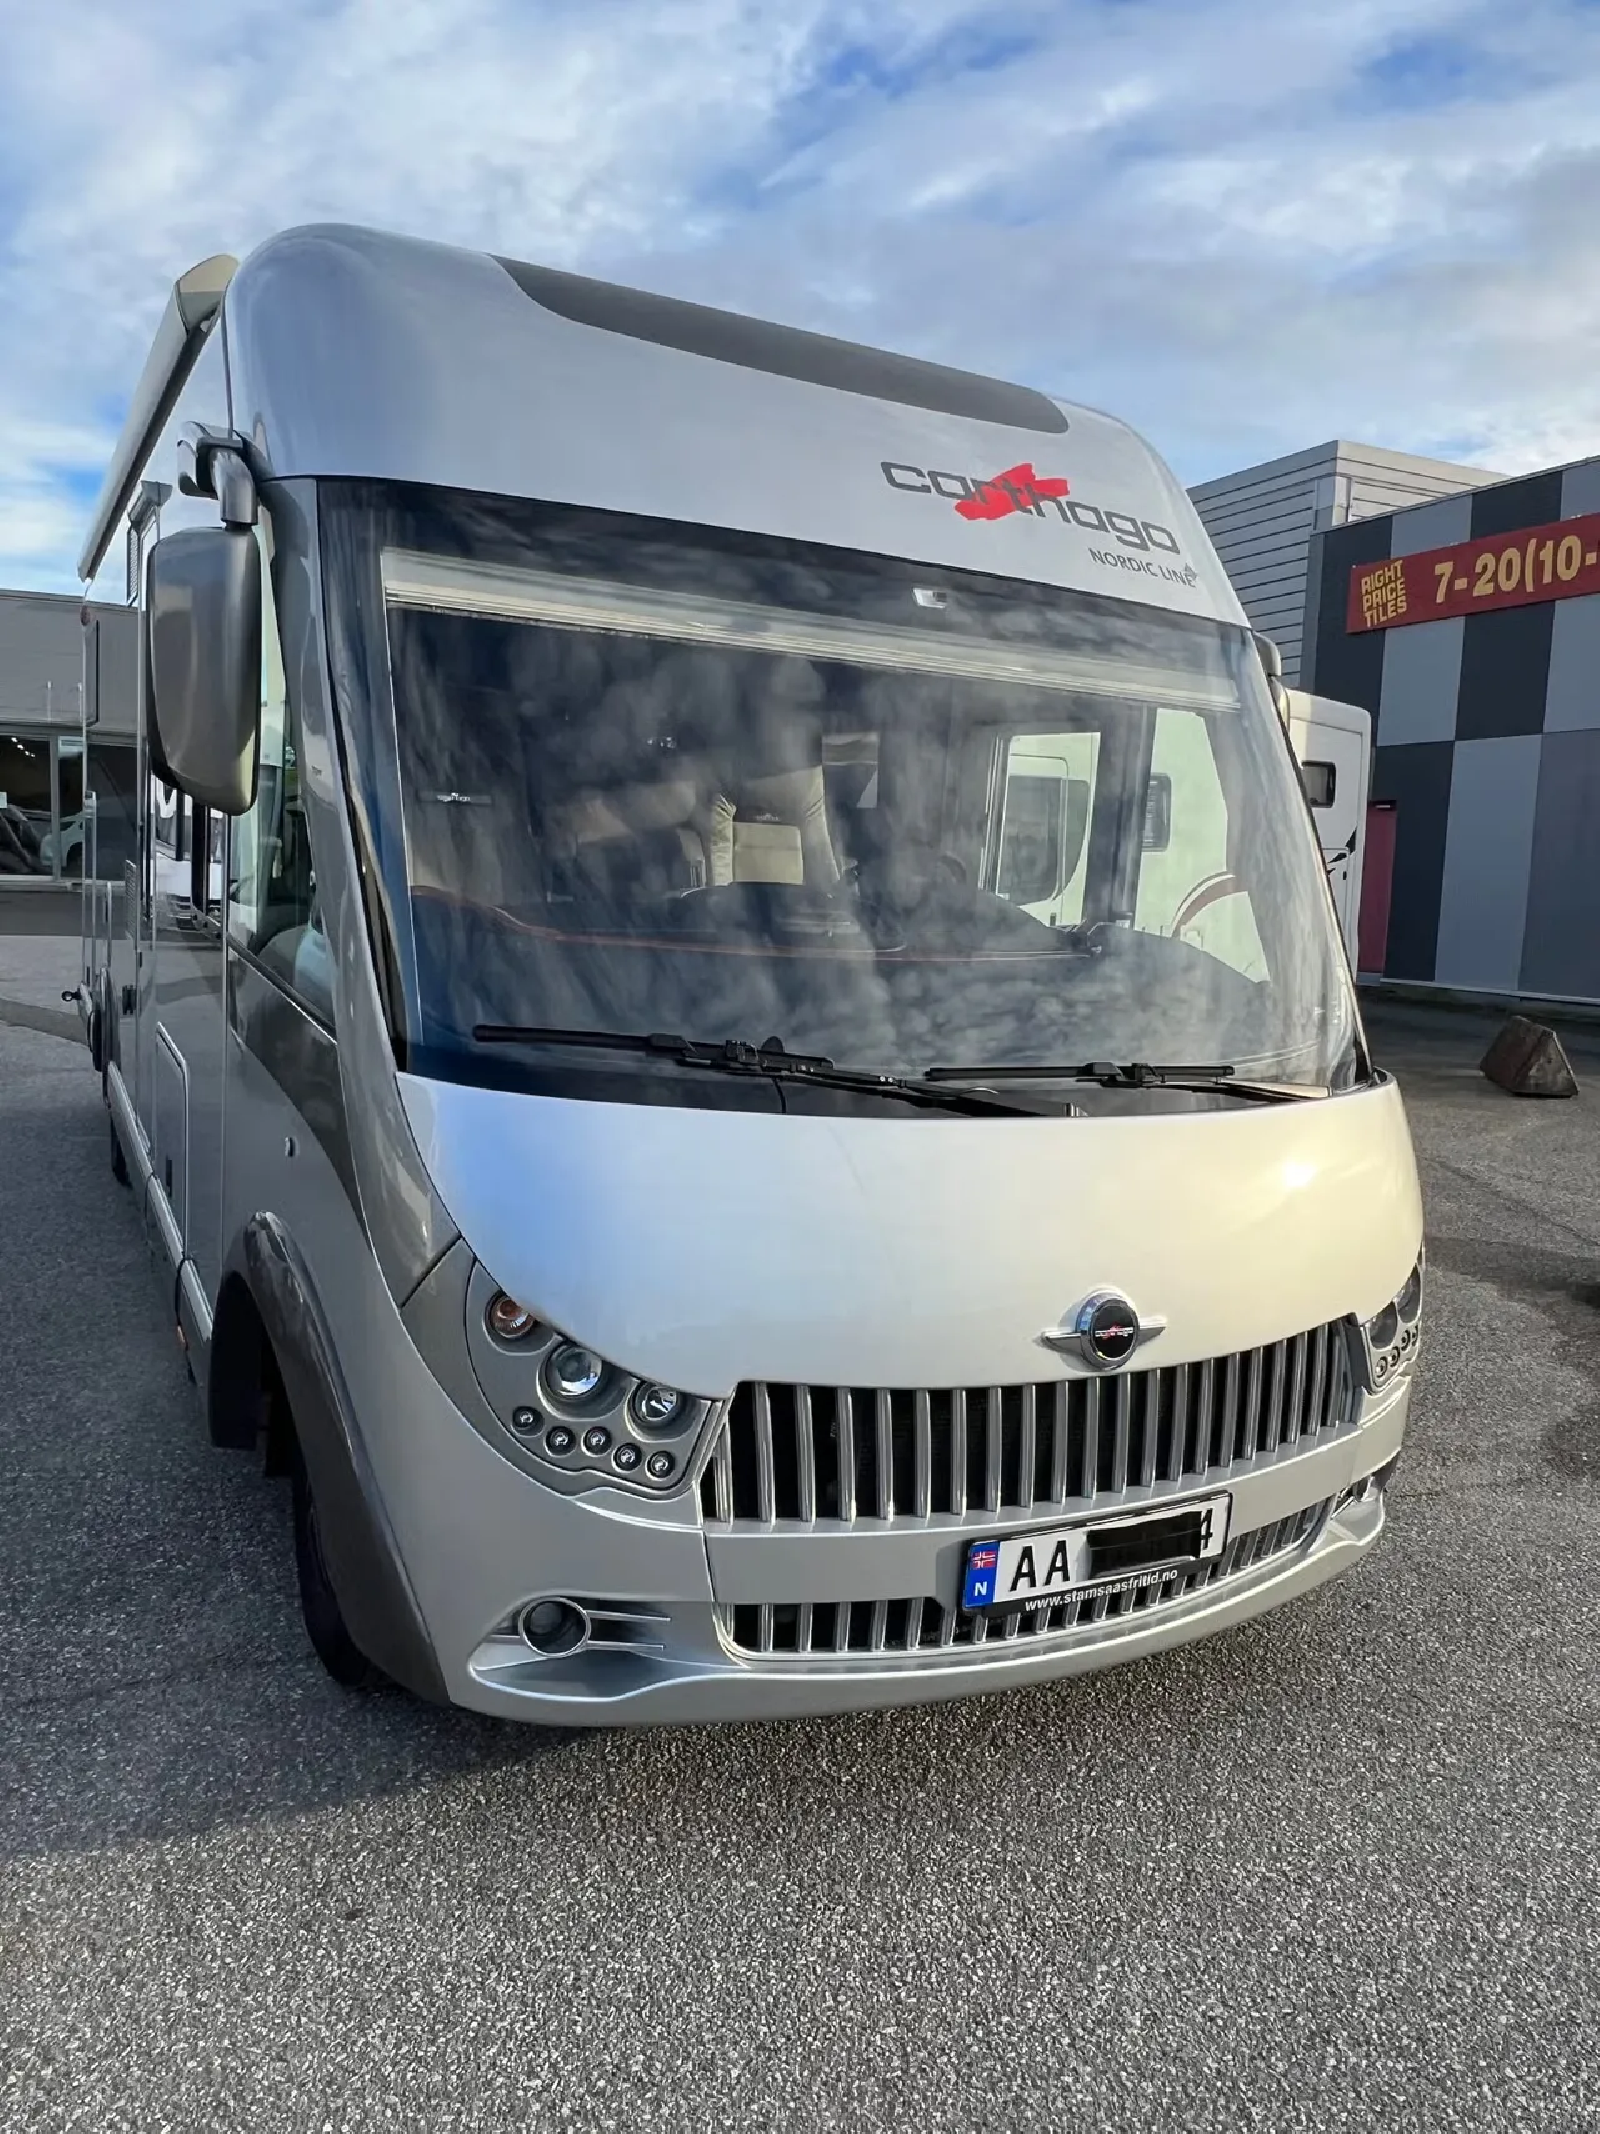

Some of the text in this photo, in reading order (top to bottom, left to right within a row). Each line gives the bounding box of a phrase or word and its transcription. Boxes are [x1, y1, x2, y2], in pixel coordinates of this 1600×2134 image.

[881, 461, 1180, 555] carthago
[1088, 547, 1196, 588] NORDIC LINE
[1361, 560, 1403, 596] RIGHT
[1363, 577, 1406, 613] PRICE
[1365, 596, 1407, 628] TILES
[1010, 1539, 1071, 1593] AA
[974, 1582, 987, 1597] N
